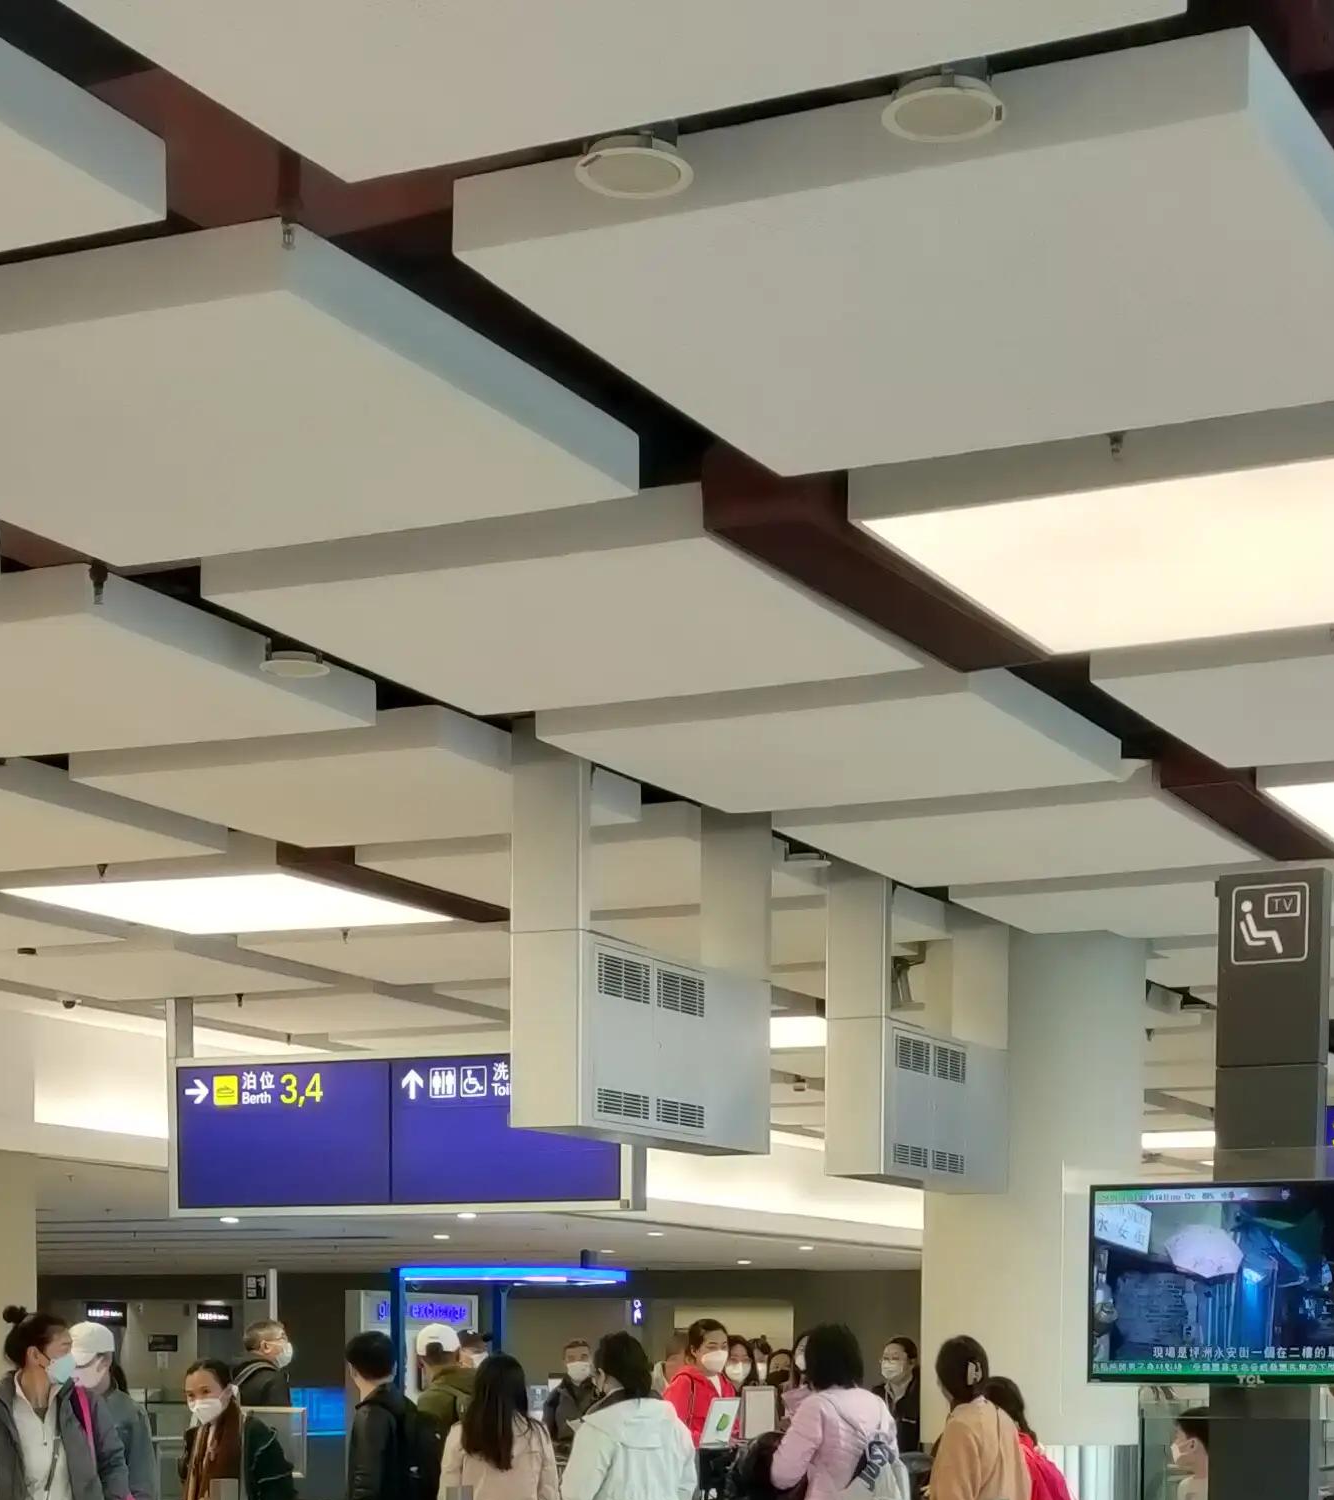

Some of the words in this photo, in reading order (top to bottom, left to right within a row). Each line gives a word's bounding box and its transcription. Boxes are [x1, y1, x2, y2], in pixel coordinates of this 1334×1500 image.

[1271, 897, 1294, 912] TV
[492, 1061, 509, 1081] 洗
[241, 1070, 275, 1090] 泊位
[241, 1090, 272, 1105] Berth
[280, 1072, 324, 1108] 3,4
[1237, 1375, 1265, 1384] TCL
